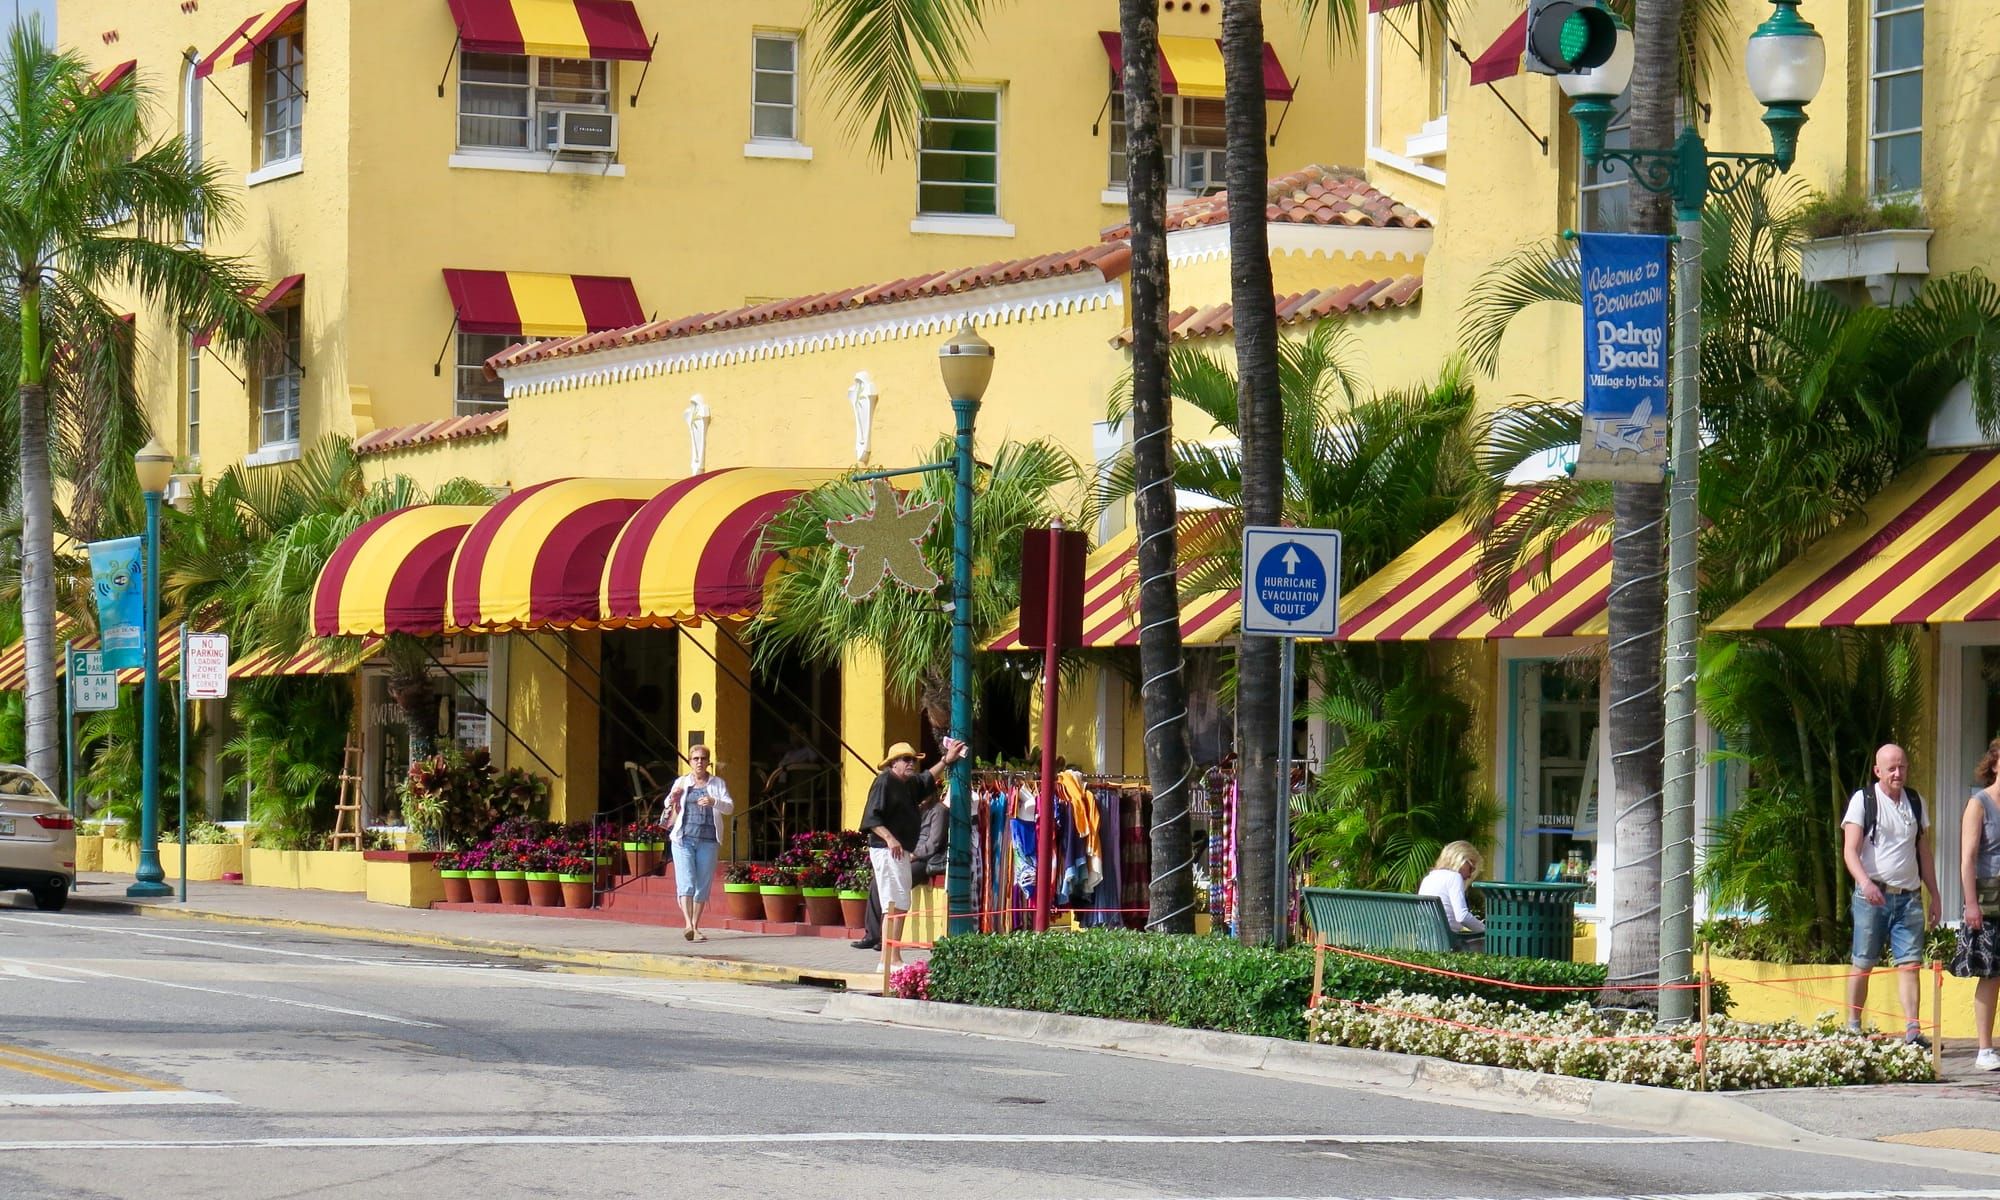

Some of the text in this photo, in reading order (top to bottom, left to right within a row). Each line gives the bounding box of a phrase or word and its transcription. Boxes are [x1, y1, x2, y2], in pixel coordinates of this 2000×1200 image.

[1587, 261, 1660, 291] Welcome to
[1593, 287, 1663, 317] Downtown
[1597, 320, 1662, 349] Delray
[1598, 344, 1660, 372] Beach
[1590, 374, 1624, 389] Village
[1626, 374, 1637, 389] by
[1639, 375, 1652, 387] the
[1264, 576, 1318, 589] HURRICANE
[1262, 590, 1319, 602] EVACUATION
[1273, 603, 1306, 615] ROUTE
[202, 639, 214, 648] NO
[191, 649, 224, 657] PARKING
[76, 657, 86, 672] 2
[194, 657, 222, 665] LOADING
[87, 664, 103, 672] PAR
[83, 676, 108, 686] 8 AM
[83, 691, 108, 701] 8 PM
